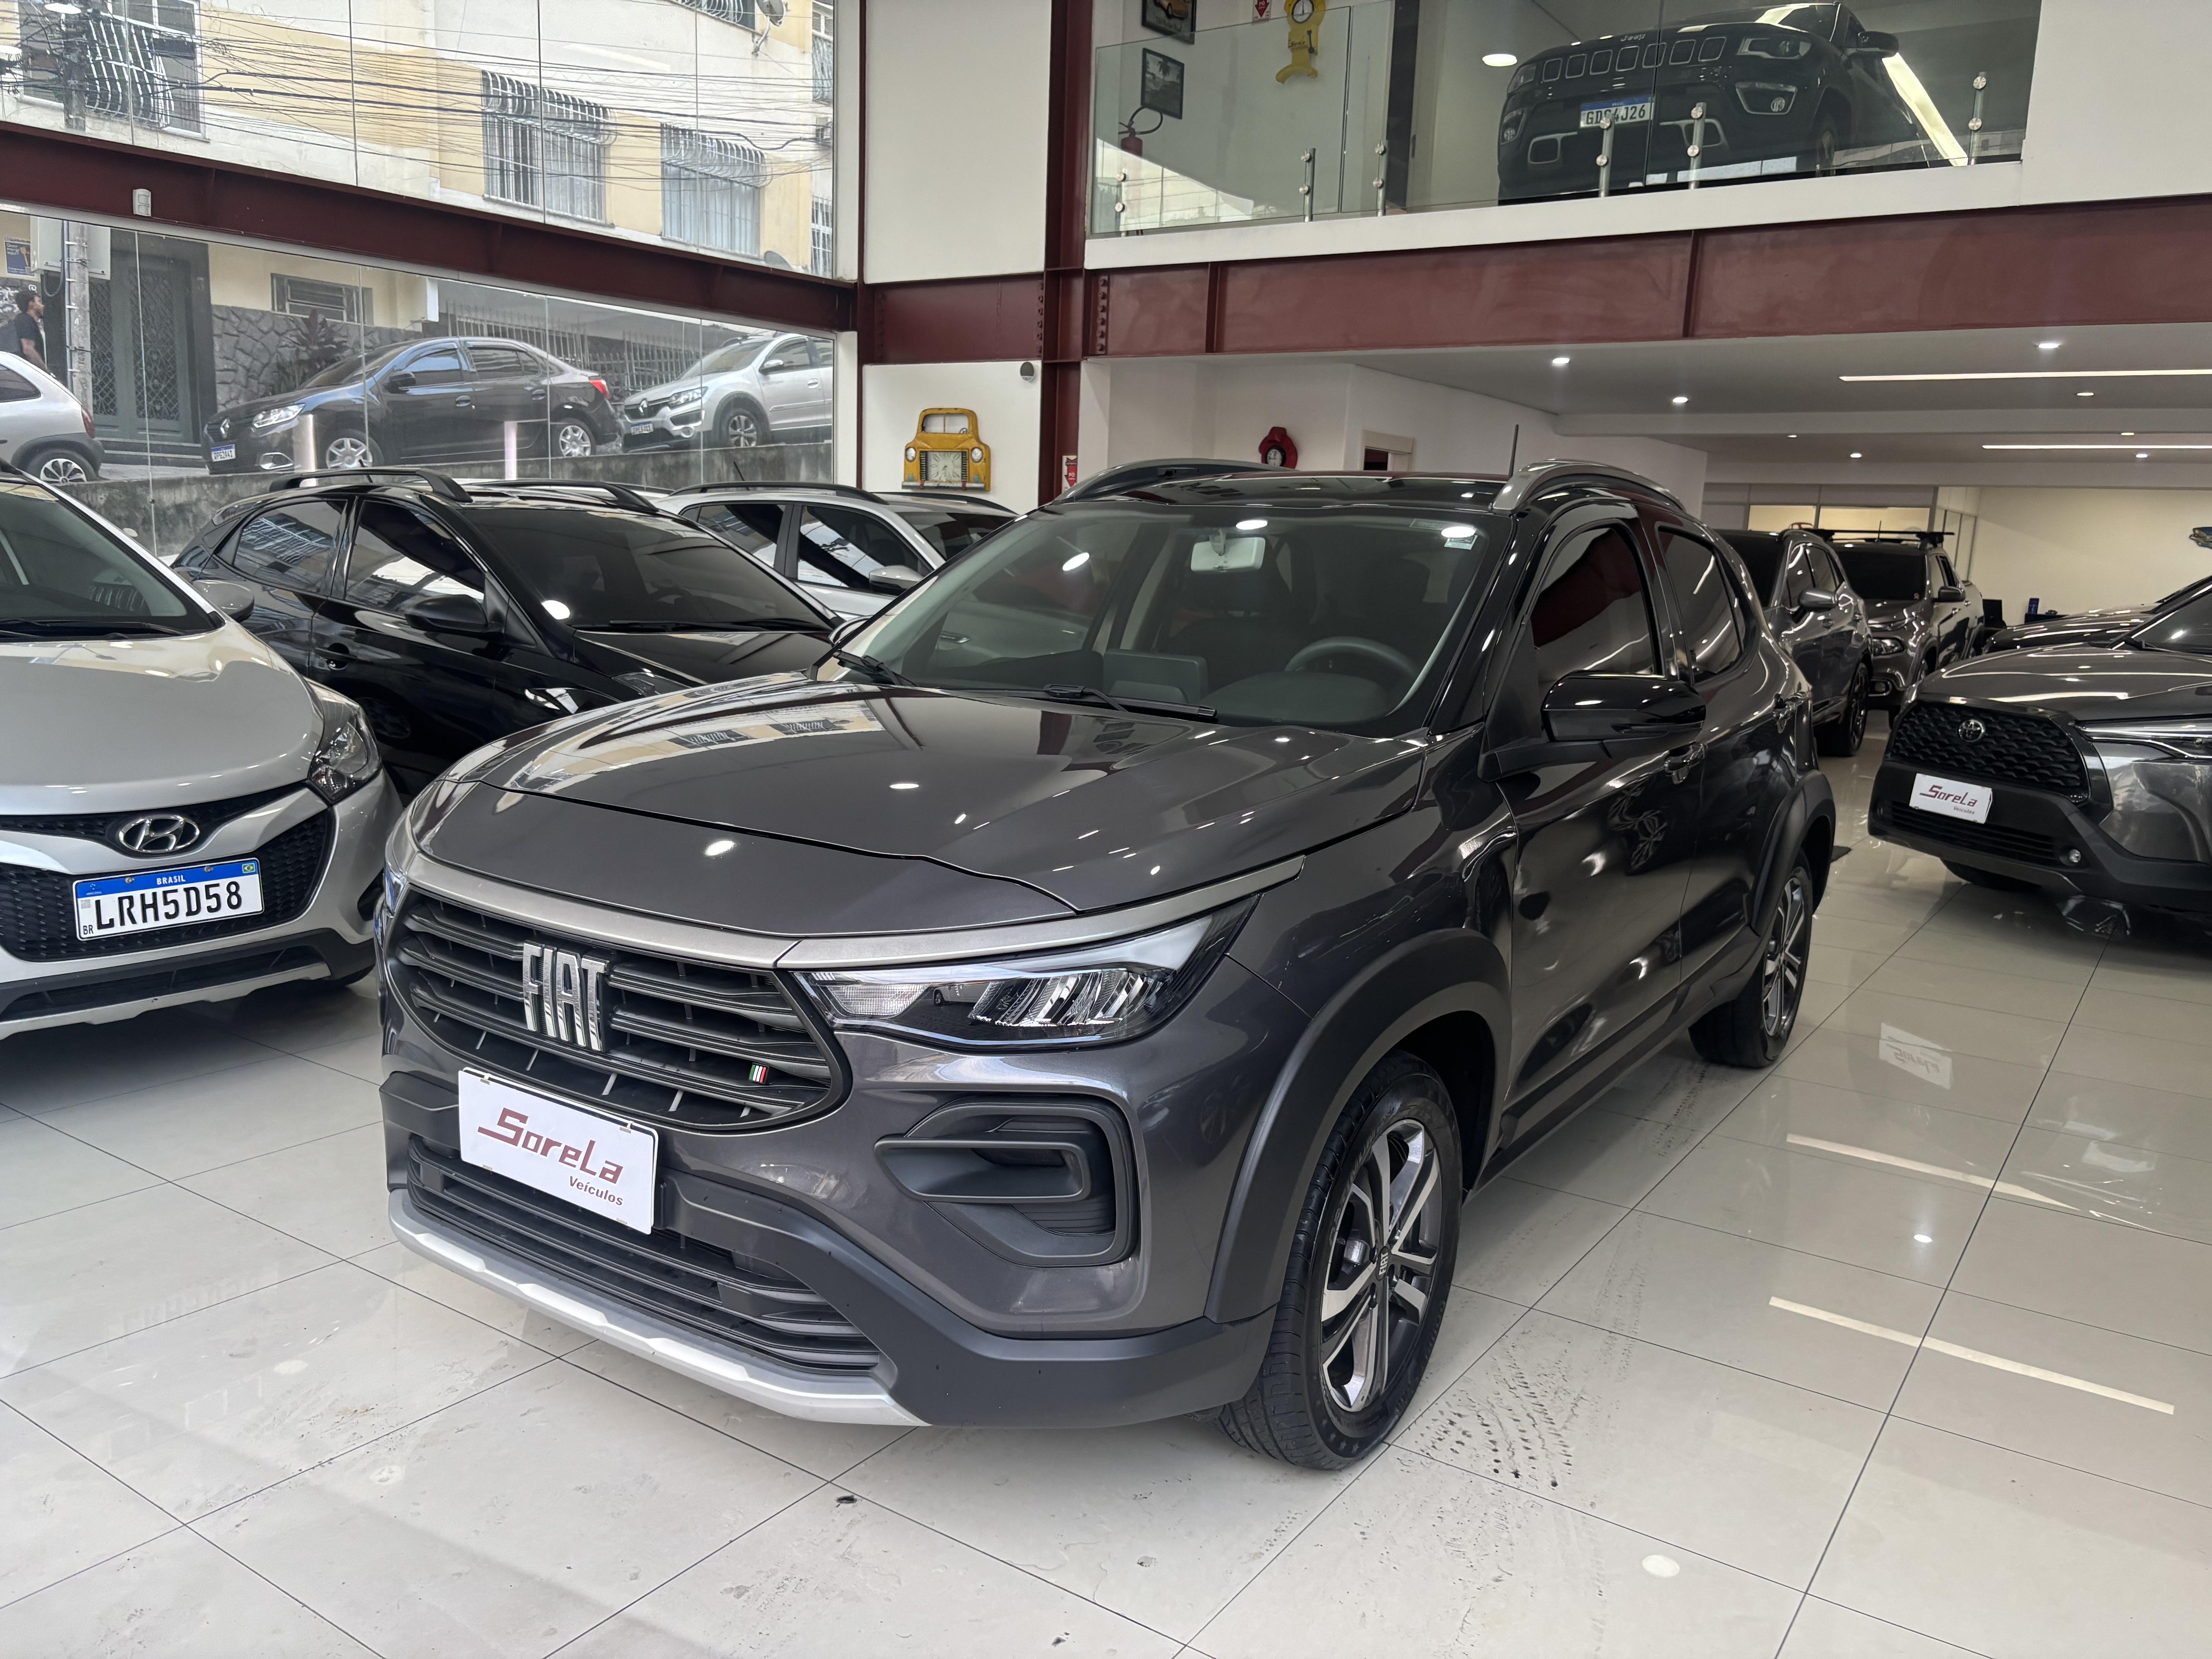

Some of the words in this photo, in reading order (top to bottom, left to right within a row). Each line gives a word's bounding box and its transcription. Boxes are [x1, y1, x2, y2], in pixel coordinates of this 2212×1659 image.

[156, 875, 186, 885] BRASIL
[95, 881, 242, 930] LRH5D58
[82, 925, 94, 935] BR
[523, 941, 607, 1051] FIAT
[569, 1176, 623, 1206] Veículos
[1379, 1252, 1388, 1276] FIAT
